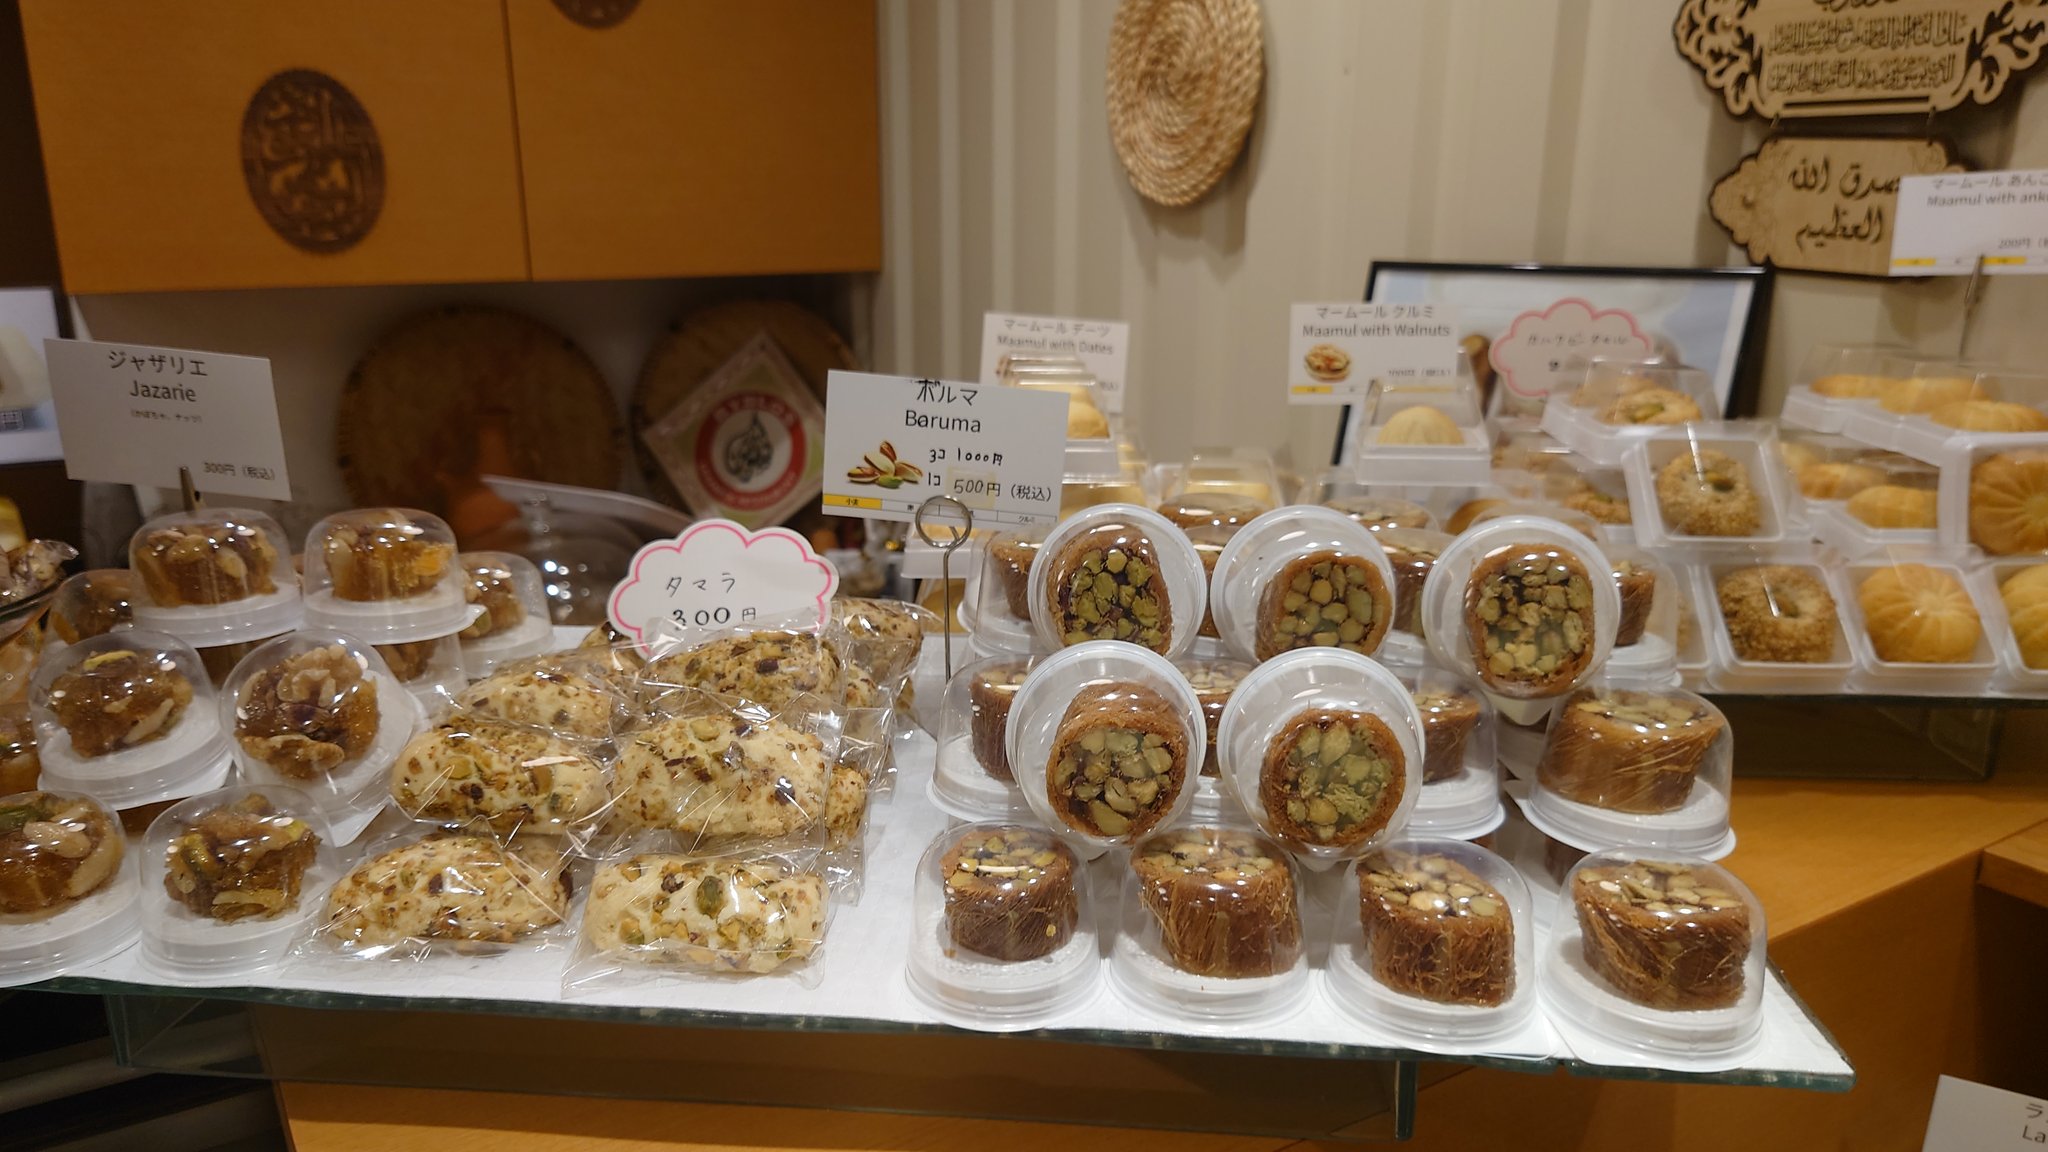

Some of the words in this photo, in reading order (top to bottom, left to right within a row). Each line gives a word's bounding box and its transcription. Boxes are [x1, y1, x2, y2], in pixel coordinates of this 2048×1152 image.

[1788, 155, 1830, 194] الله
[1985, 193, 2015, 205] with
[2020, 191, 2048, 205] ank
[1795, 203, 1883, 251] العظيم
[1302, 324, 1357, 338] Maamul
[1360, 324, 1390, 337] with
[1394, 323, 1450, 337] Walnuts
[108, 351, 208, 377] ジャザリエ
[130, 380, 197, 402] Jazarie
[914, 380, 978, 406] ボルマ
[905, 409, 981, 433] Baruma
[666, 572, 736, 598] タマラ
